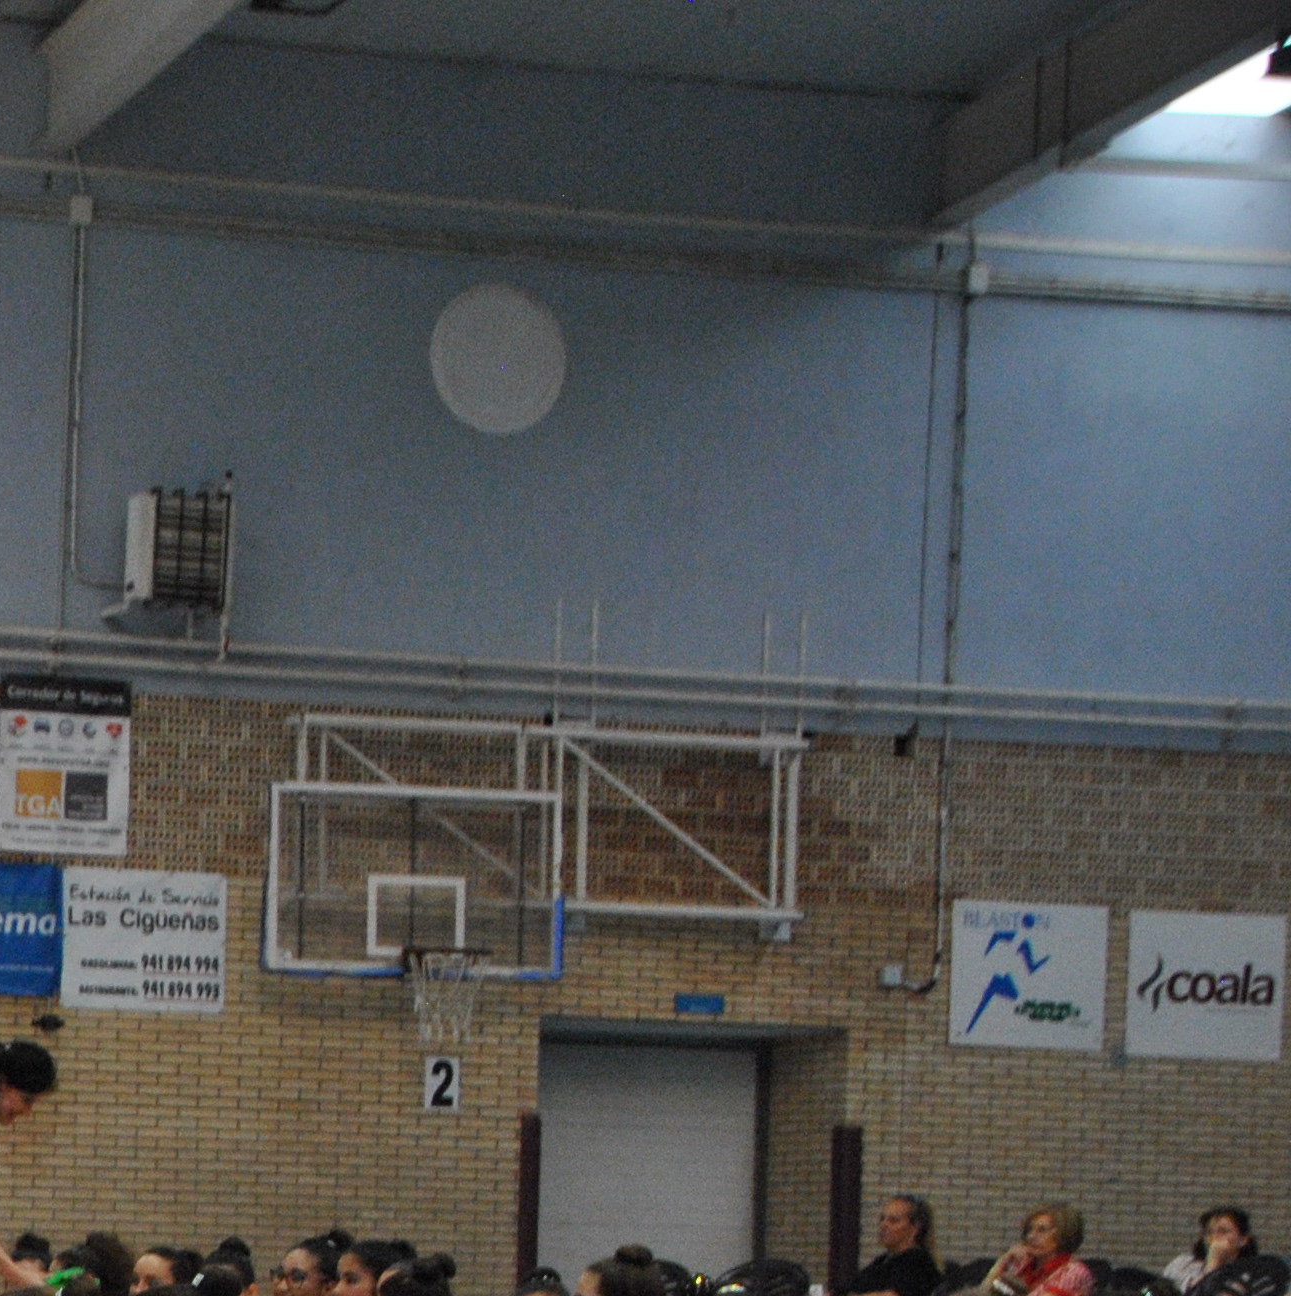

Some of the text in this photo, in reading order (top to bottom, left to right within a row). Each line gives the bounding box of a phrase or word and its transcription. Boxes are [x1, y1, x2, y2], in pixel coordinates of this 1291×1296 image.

[16, 793, 61, 817] TGA
[68, 905, 220, 937] Las Cigüeñas
[142, 952, 164, 970] 941
[168, 953, 192, 972] 894
[195, 955, 219, 973] 994
[143, 979, 165, 997] 941
[169, 980, 193, 999] 894
[1167, 962, 1275, 1006] coala
[431, 1060, 454, 1107] 2
